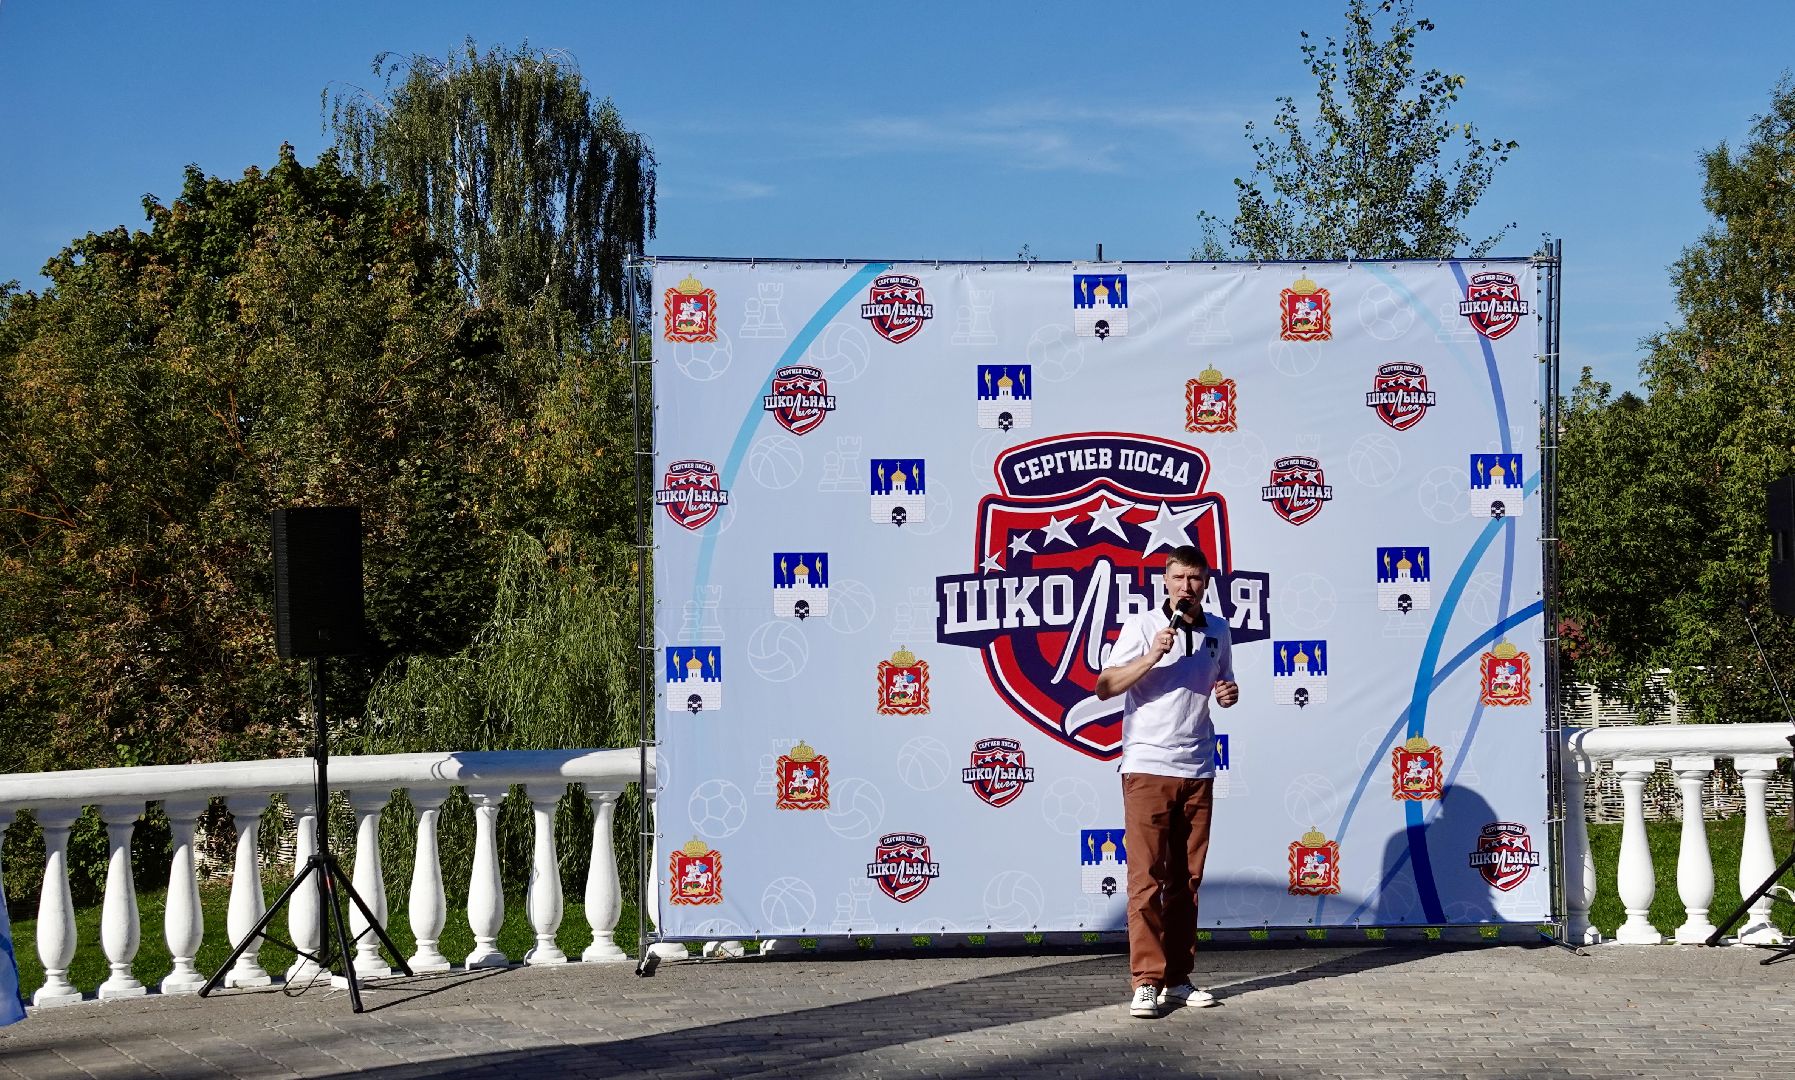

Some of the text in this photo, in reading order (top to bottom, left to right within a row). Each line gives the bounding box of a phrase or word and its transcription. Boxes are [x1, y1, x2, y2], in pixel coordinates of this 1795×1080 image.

[862, 302, 932, 318] ШКОЛЬНАЯ
[1460, 299, 1528, 314] ШКОЛЬНАЯ
[764, 393, 835, 409] ШКОЛЬНАЯ
[1367, 390, 1435, 405] ШКОЛЬНАЯ
[1013, 448, 1191, 486] СЕРГИЕВ ПОСАД
[657, 488, 727, 504] ШКОЛЬНАЯ
[1263, 484, 1332, 500] ШКОЛЬНАЯ
[963, 766, 1033, 782] ШКОЛЬНАЯ
[1470, 850, 1540, 866] ШКОЛЬНАЯ
[868, 861, 939, 877] ШКОЛЬНАЯ
